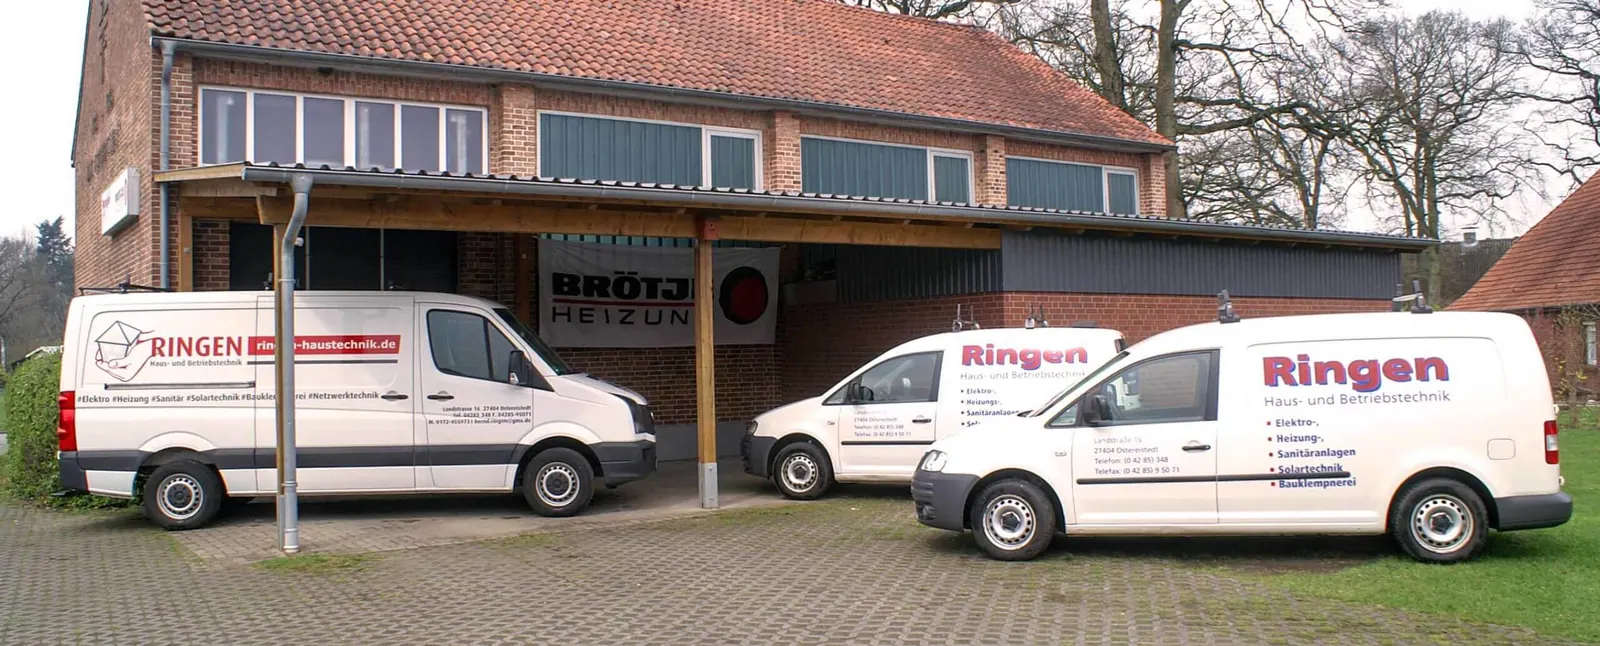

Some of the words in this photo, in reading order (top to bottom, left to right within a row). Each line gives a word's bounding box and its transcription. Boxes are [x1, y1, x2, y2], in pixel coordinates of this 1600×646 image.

[552, 271, 700, 300] BRÖTJ
[552, 306, 689, 325] HEIZUN
[151, 336, 242, 357] RINGEN
[256, 340, 396, 350] rin-haustechnik.de
[962, 344, 1088, 370] Ringen
[960, 372, 987, 380] Haus-
[1012, 370, 1086, 379] Betriebstechnik
[1262, 354, 1450, 392] Ringen
[112, 396, 149, 404] #Heizung
[151, 394, 184, 402] #Sanitär
[186, 394, 240, 402] #Solartechnik
[308, 392, 380, 400] #Netzwerktechnik
[1264, 397, 1302, 406] Haus-
[1308, 394, 1335, 406] und
[1340, 390, 1450, 404] Betriebstechnik
[1276, 418, 1319, 428] Elektro-,
[1276, 434, 1324, 444] Heizung-,
[1278, 448, 1356, 458] Sanitäranlagen
[1278, 463, 1344, 474] Solartechnik
[1278, 478, 1356, 489] Bauklempnerei
